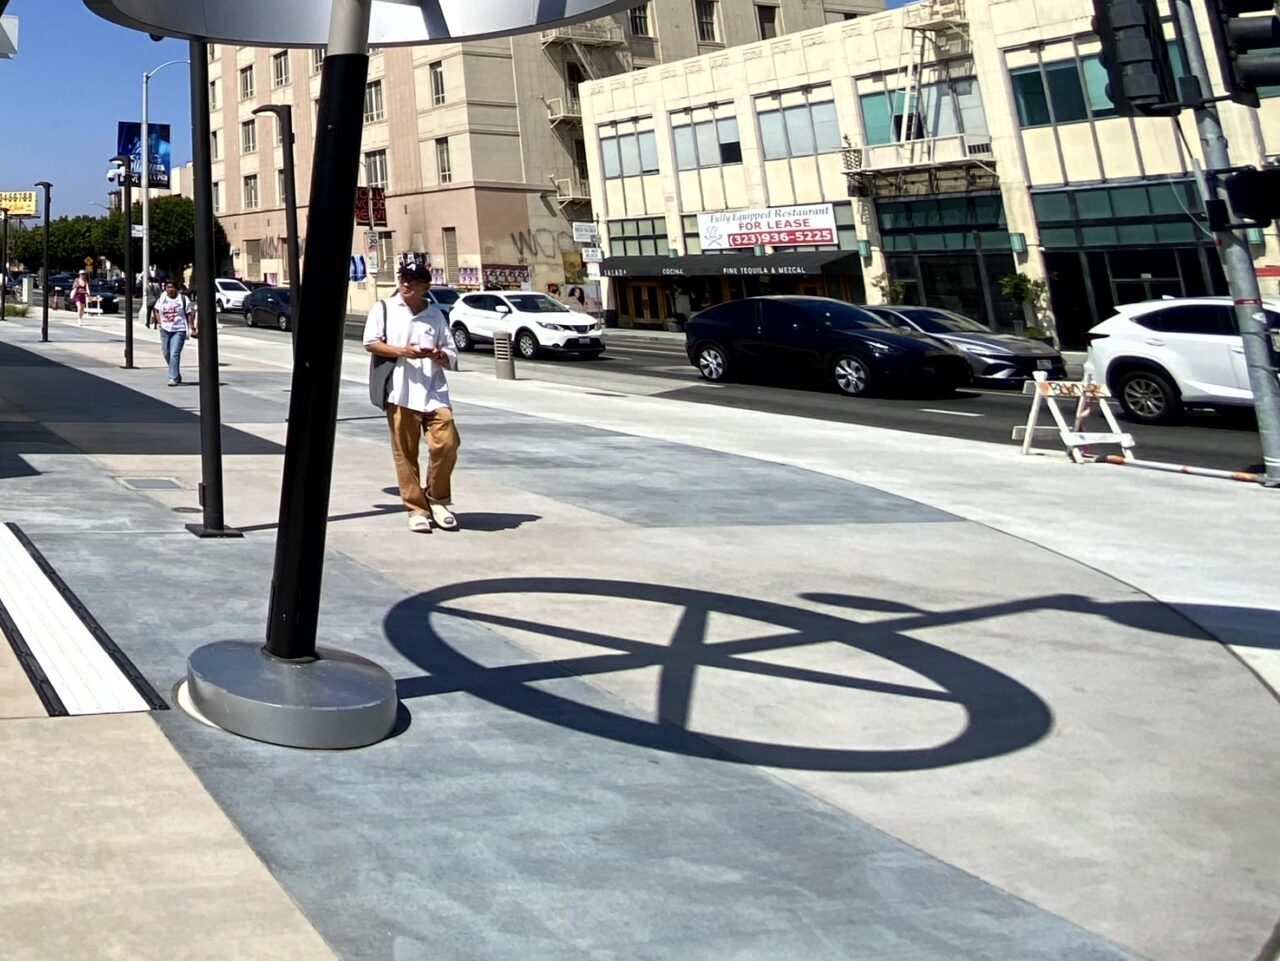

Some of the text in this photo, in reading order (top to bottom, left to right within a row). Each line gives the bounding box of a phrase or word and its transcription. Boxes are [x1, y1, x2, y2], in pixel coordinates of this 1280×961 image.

[710, 206, 830, 225] Fully Equipped Restaurant
[738, 218, 811, 231] FOR LEASE
[728, 230, 832, 246] (323)936-5225
[722, 267, 738, 275] FINE
[740, 267, 768, 275] TEQUILA
[778, 266, 807, 274] MEZCAL
